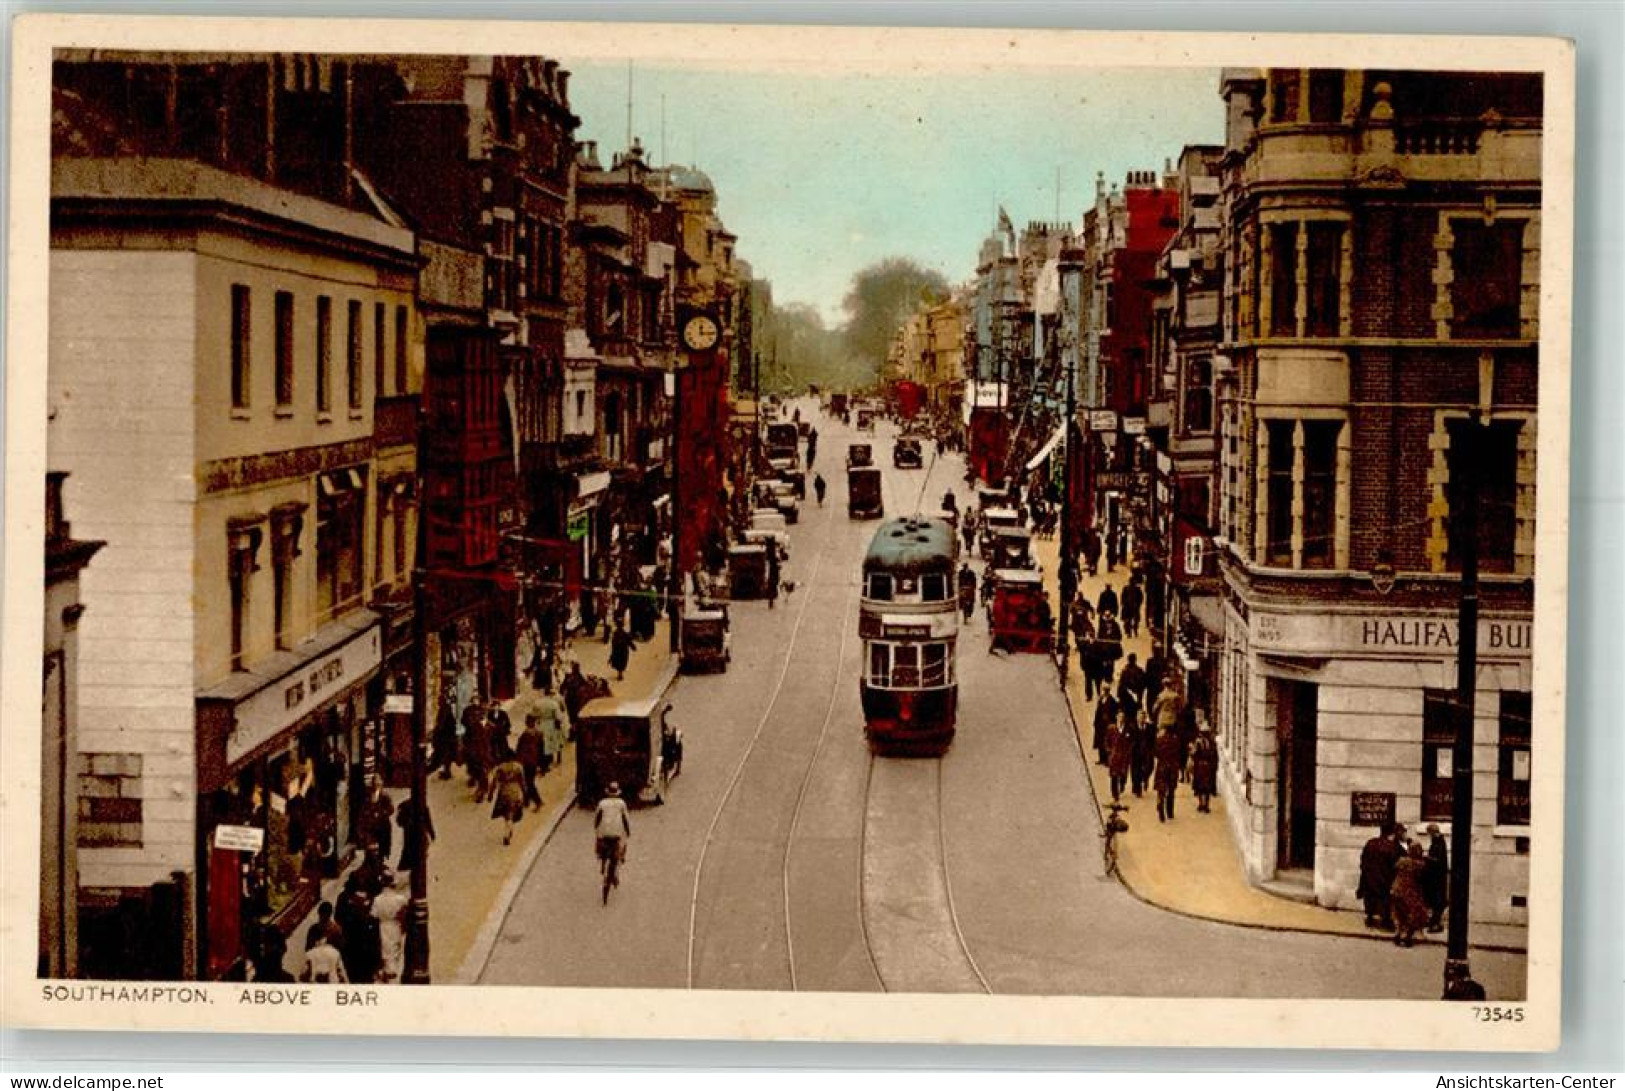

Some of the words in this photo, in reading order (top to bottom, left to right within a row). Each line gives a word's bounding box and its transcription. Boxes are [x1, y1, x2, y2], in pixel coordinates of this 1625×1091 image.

[1362, 621, 1459, 647] HALIFA
[42, 986, 214, 1004] SOUTHAMPTON.
[239, 990, 312, 1005] ABOVE
[336, 990, 379, 1006] BAR
[1472, 1007, 1525, 1022] 73545
